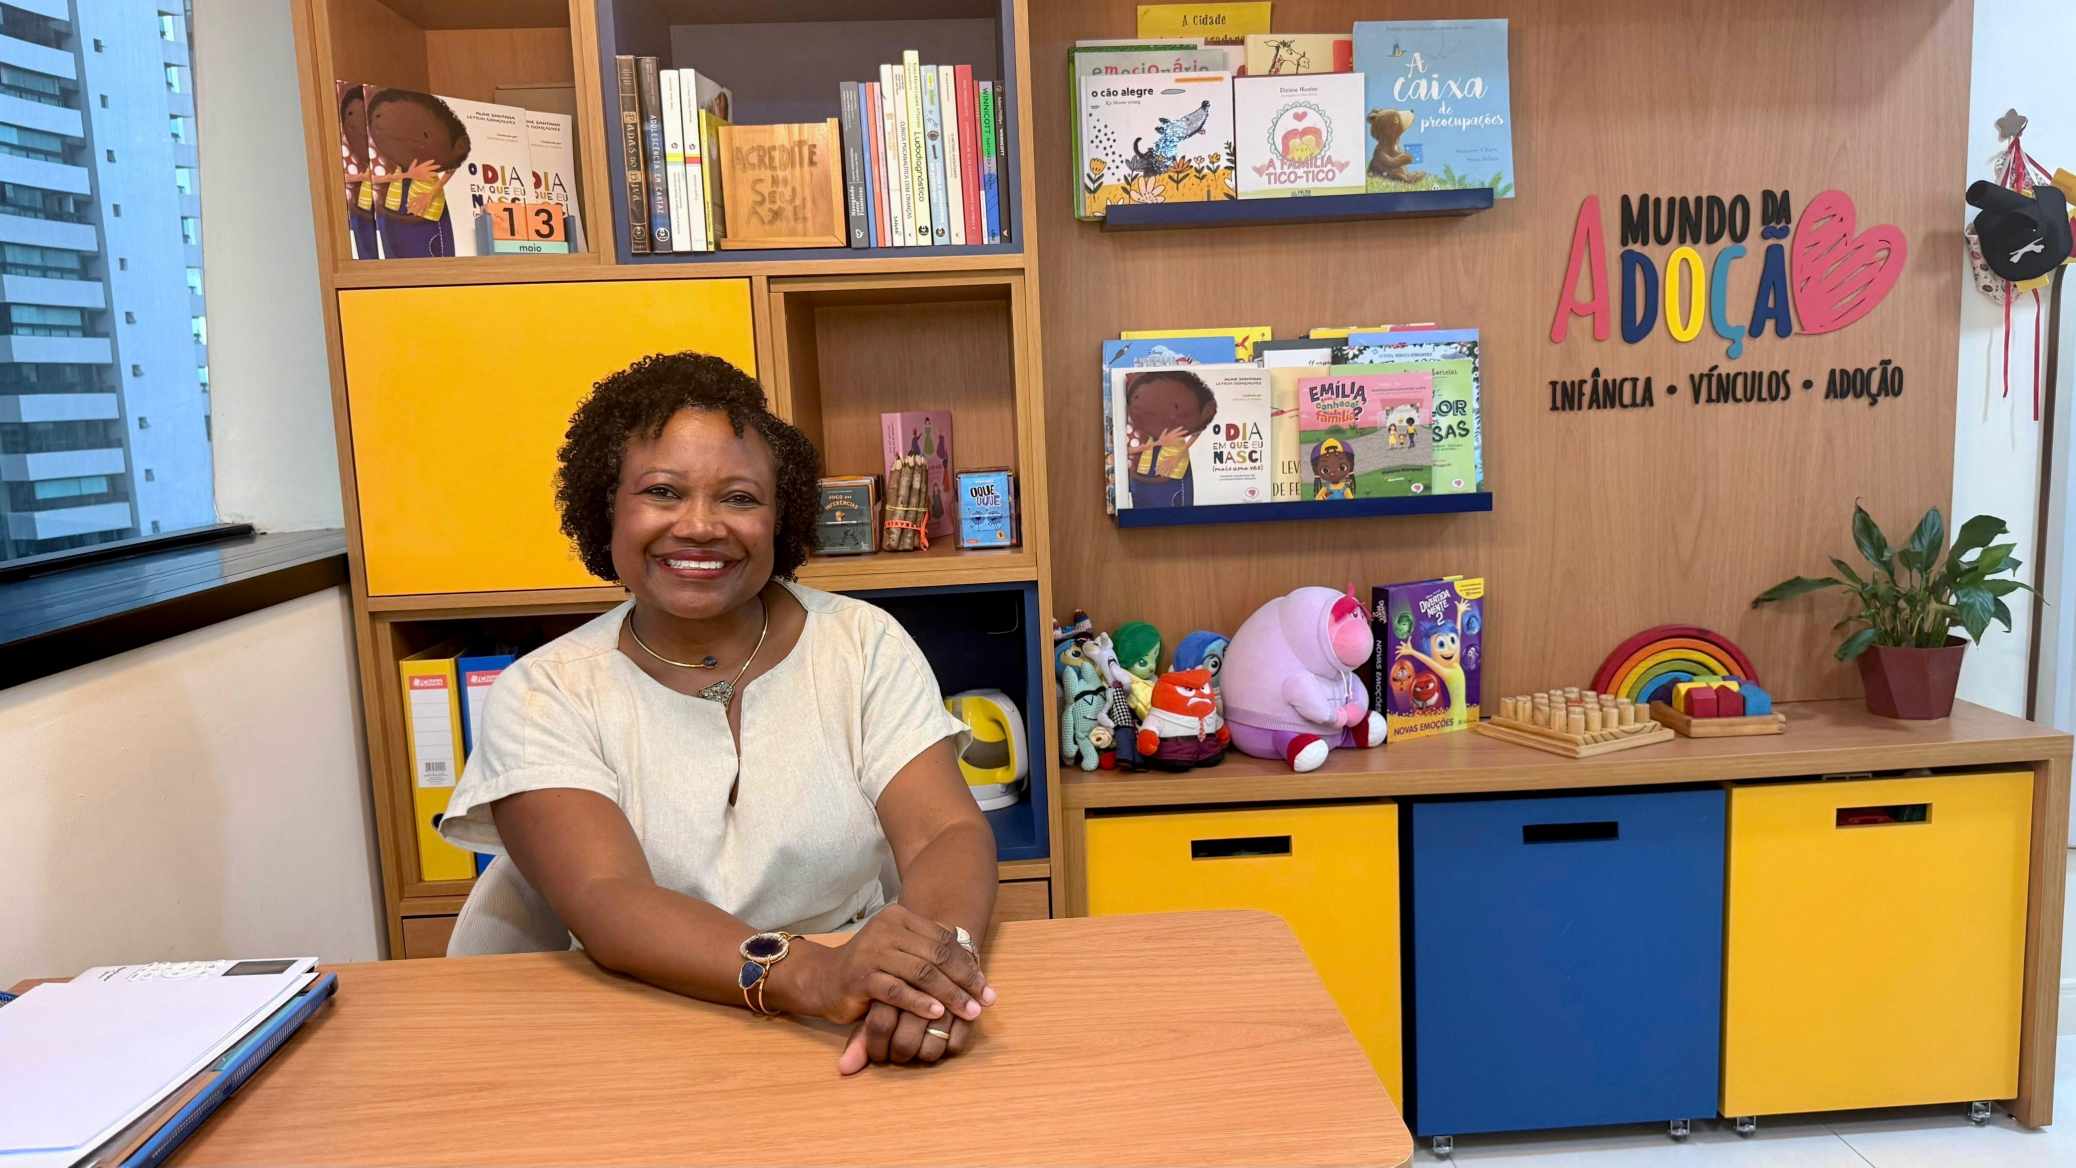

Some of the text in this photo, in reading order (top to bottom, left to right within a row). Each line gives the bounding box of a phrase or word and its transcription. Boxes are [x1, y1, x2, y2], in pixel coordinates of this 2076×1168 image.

[1182, 13, 1226, 27] A Cidade
[1405, 52, 1428, 79] A
[1091, 87, 1154, 98] o cão alegre
[1393, 73, 1488, 102] caixa
[981, 88, 991, 135] WINNICOTT
[1438, 101, 1454, 115] de
[1420, 113, 1504, 134] preocupações
[912, 131, 925, 203] Ludodiagnóstico
[1266, 158, 1276, 171] A
[468, 162, 525, 188] O DIA
[1265, 169, 1336, 185] TICO-TICO
[470, 184, 527, 197] EM QUE EU
[1619, 189, 1792, 247] MUNDO DA
[519, 244, 542, 253] maio
[1549, 358, 1905, 412] INFÂNCIA VÍNCULOS ADOÇÃO
[1432, 399, 1467, 417] OR
[1212, 421, 1263, 442] O DIA
[1212, 440, 1264, 450] EM QUE EU
[1213, 449, 1263, 465] NASCI
[1272, 481, 1286, 497] DE
[1419, 589, 1452, 613] DIVERTIDA
[1426, 599, 1450, 619] MENTE
[1435, 611, 1446, 626] 2
[1393, 718, 1455, 737] NOVAS EMOÇÕES
